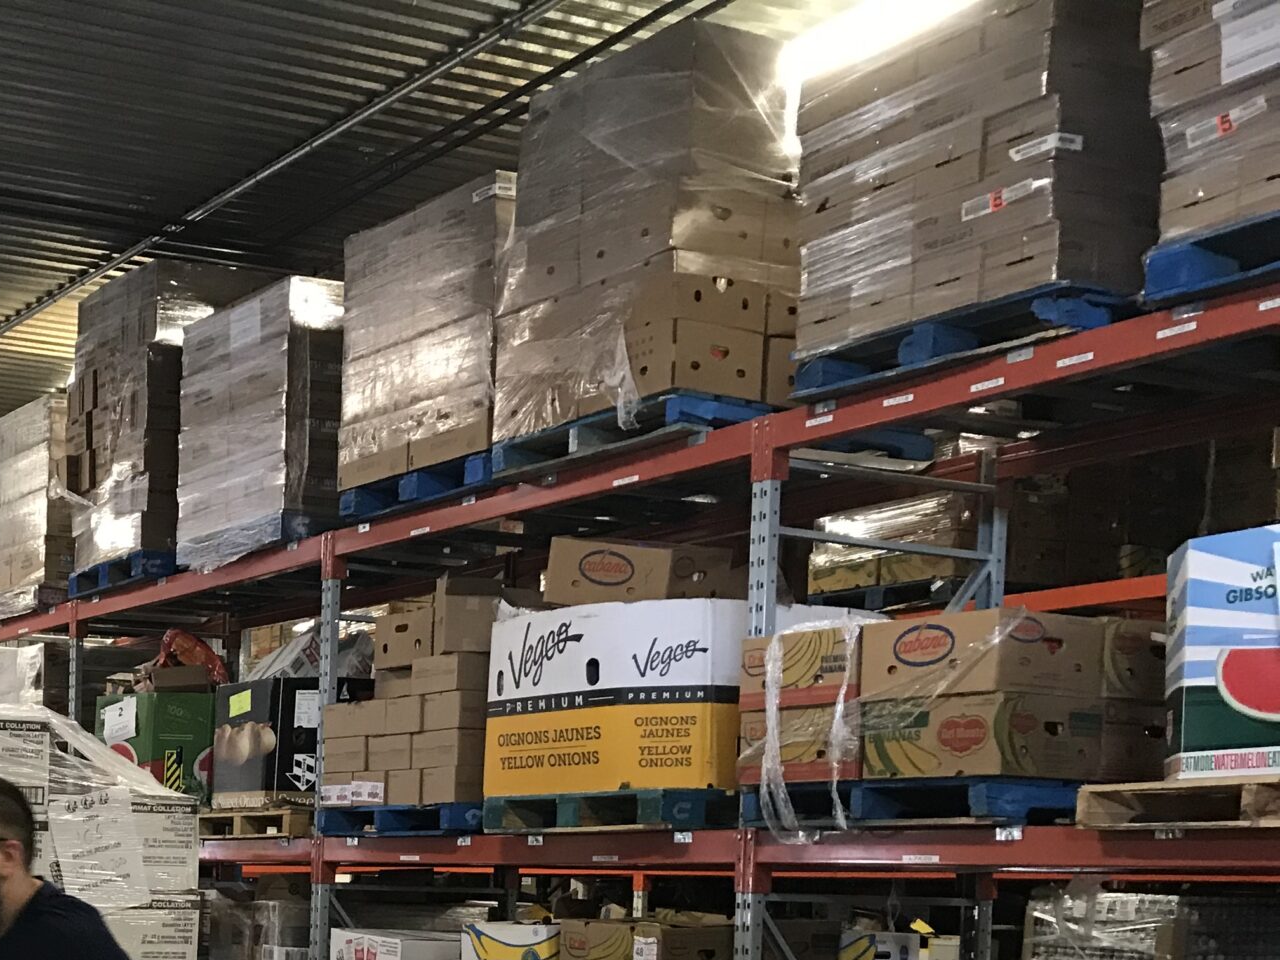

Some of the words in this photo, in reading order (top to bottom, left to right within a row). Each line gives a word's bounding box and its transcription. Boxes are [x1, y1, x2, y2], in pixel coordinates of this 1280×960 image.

[1226, 584, 1277, 604] GIBSO
[508, 620, 584, 689] Vegco
[632, 638, 709, 678] Vegco
[628, 690, 705, 700] PREMIUM
[506, 695, 584, 713] PREMIUM
[5, 722, 41, 730] COLLATION
[634, 716, 697, 728] OIGNONS
[498, 729, 550, 747] OIGNONS
[551, 726, 602, 743] JAUNES
[640, 728, 691, 739] JAUNES
[639, 745, 692, 756] YELLOW
[500, 753, 546, 771] YELLOW
[548, 750, 600, 767] ONIONS
[638, 757, 692, 769] ONIONS
